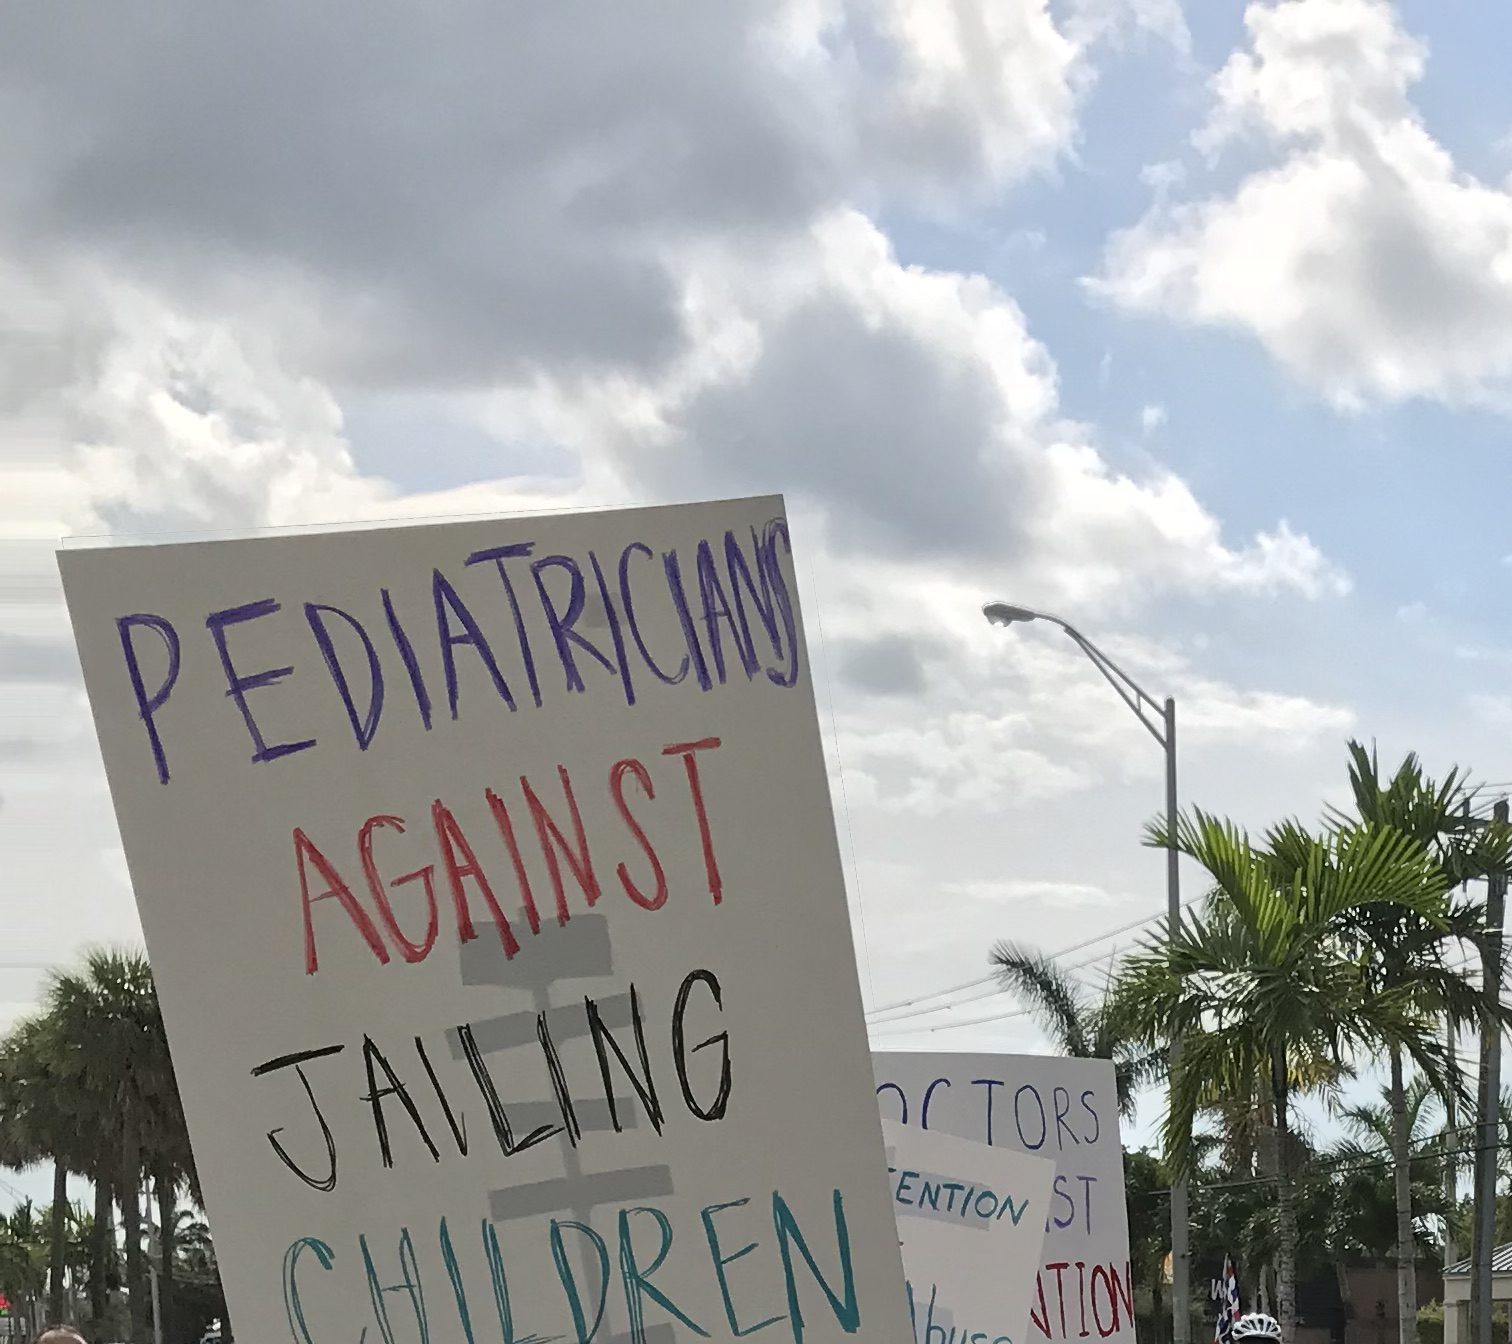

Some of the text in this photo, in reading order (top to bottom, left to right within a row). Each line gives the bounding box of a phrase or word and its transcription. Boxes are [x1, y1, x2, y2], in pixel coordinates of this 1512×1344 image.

[115, 517, 799, 785] PEDIATRICIANS
[293, 736, 721, 976] AGAINST
[251, 968, 733, 1192] JAILING
[888, 1166, 1029, 1227] ENTION
